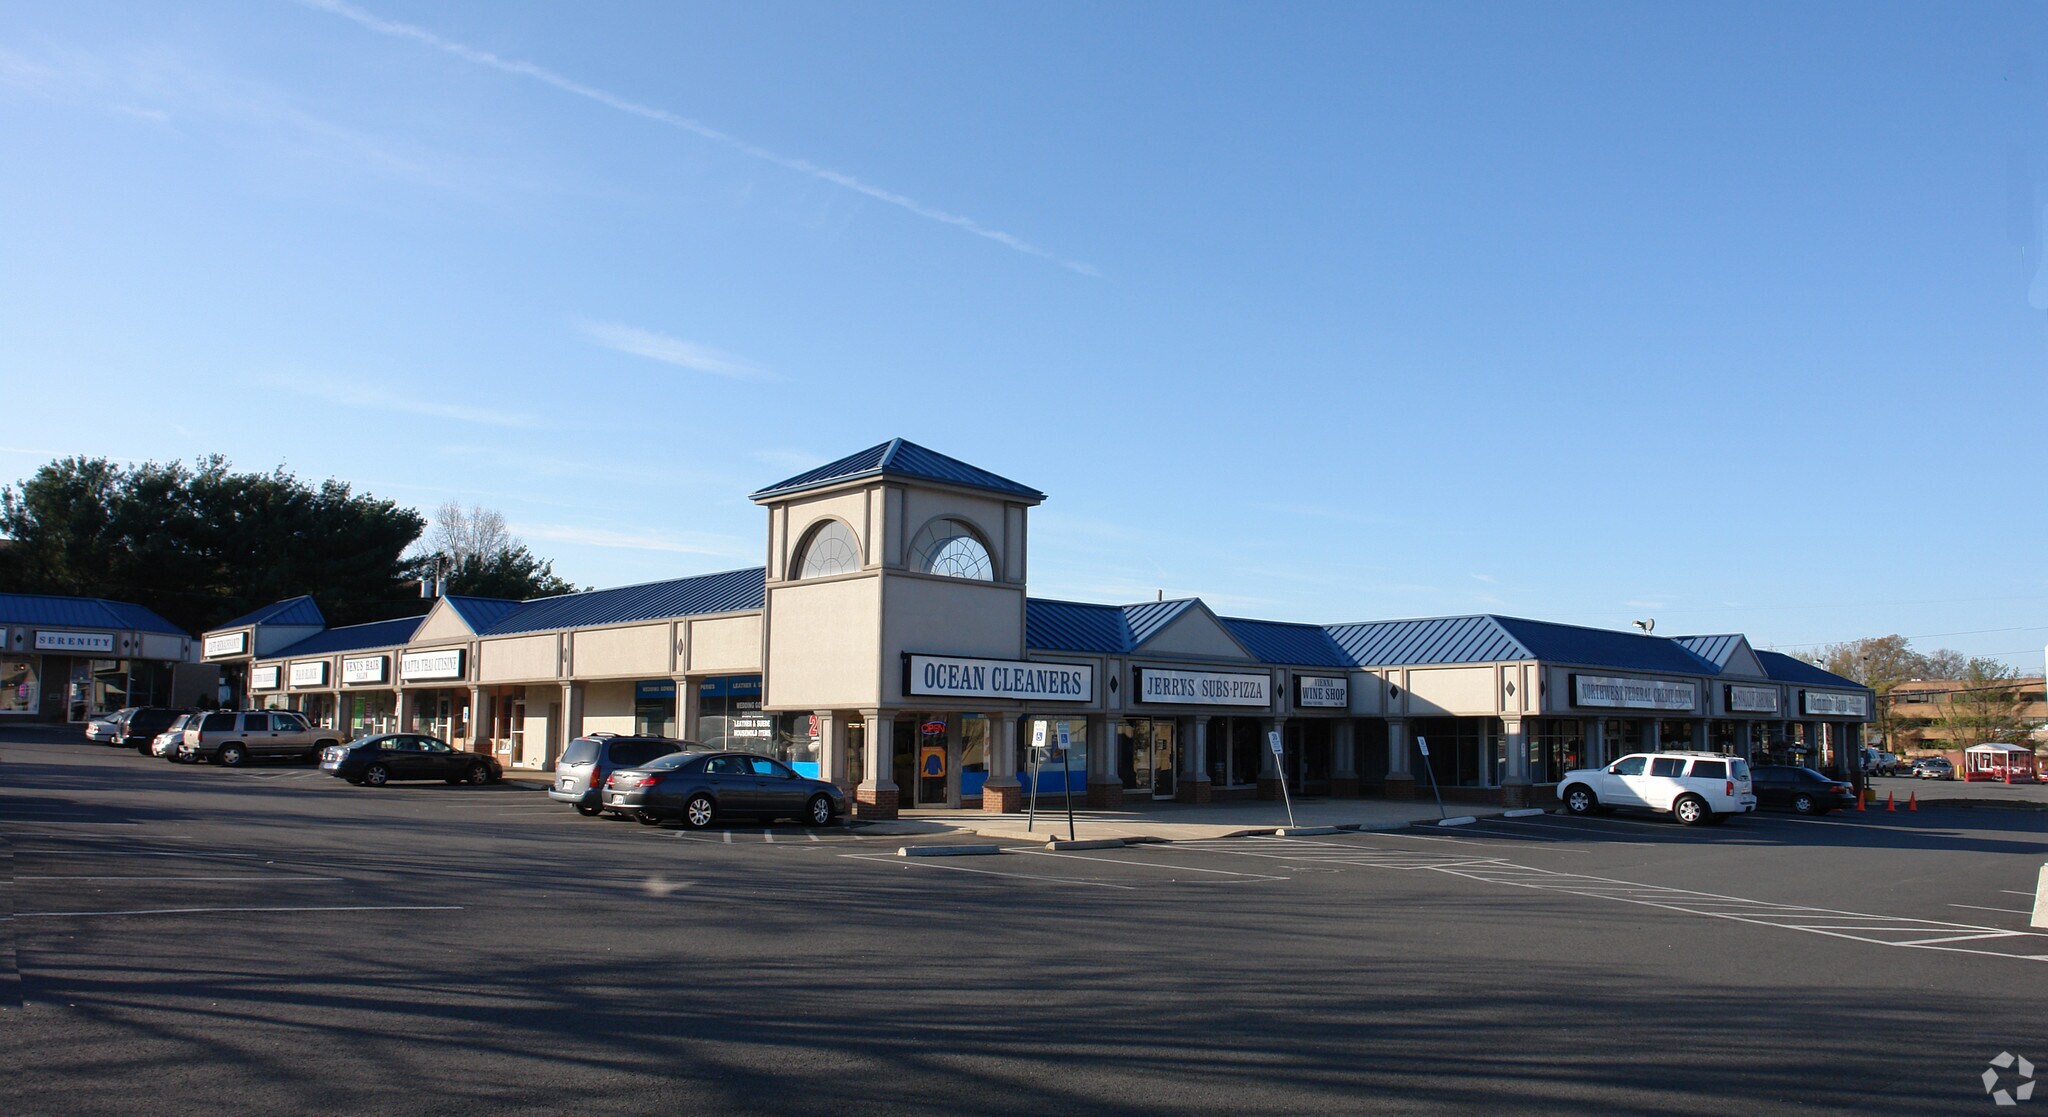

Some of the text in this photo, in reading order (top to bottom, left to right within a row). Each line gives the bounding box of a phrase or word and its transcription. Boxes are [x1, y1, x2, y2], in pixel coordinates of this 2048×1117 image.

[39, 635, 110, 647] SERENITY
[346, 659, 380, 672] VENUS HAIR
[421, 658, 433, 671] THAI
[434, 656, 457, 670] CUISINE
[924, 662, 1081, 695] OCEAN CLEANERS
[1314, 678, 1334, 687] VIENNA
[1302, 687, 1345, 701] WINE SHOP
[1582, 683, 1623, 701] NORTHWEST
[1624, 686, 1653, 702] FEDERAL
[920, 723, 946, 733] OPEN
